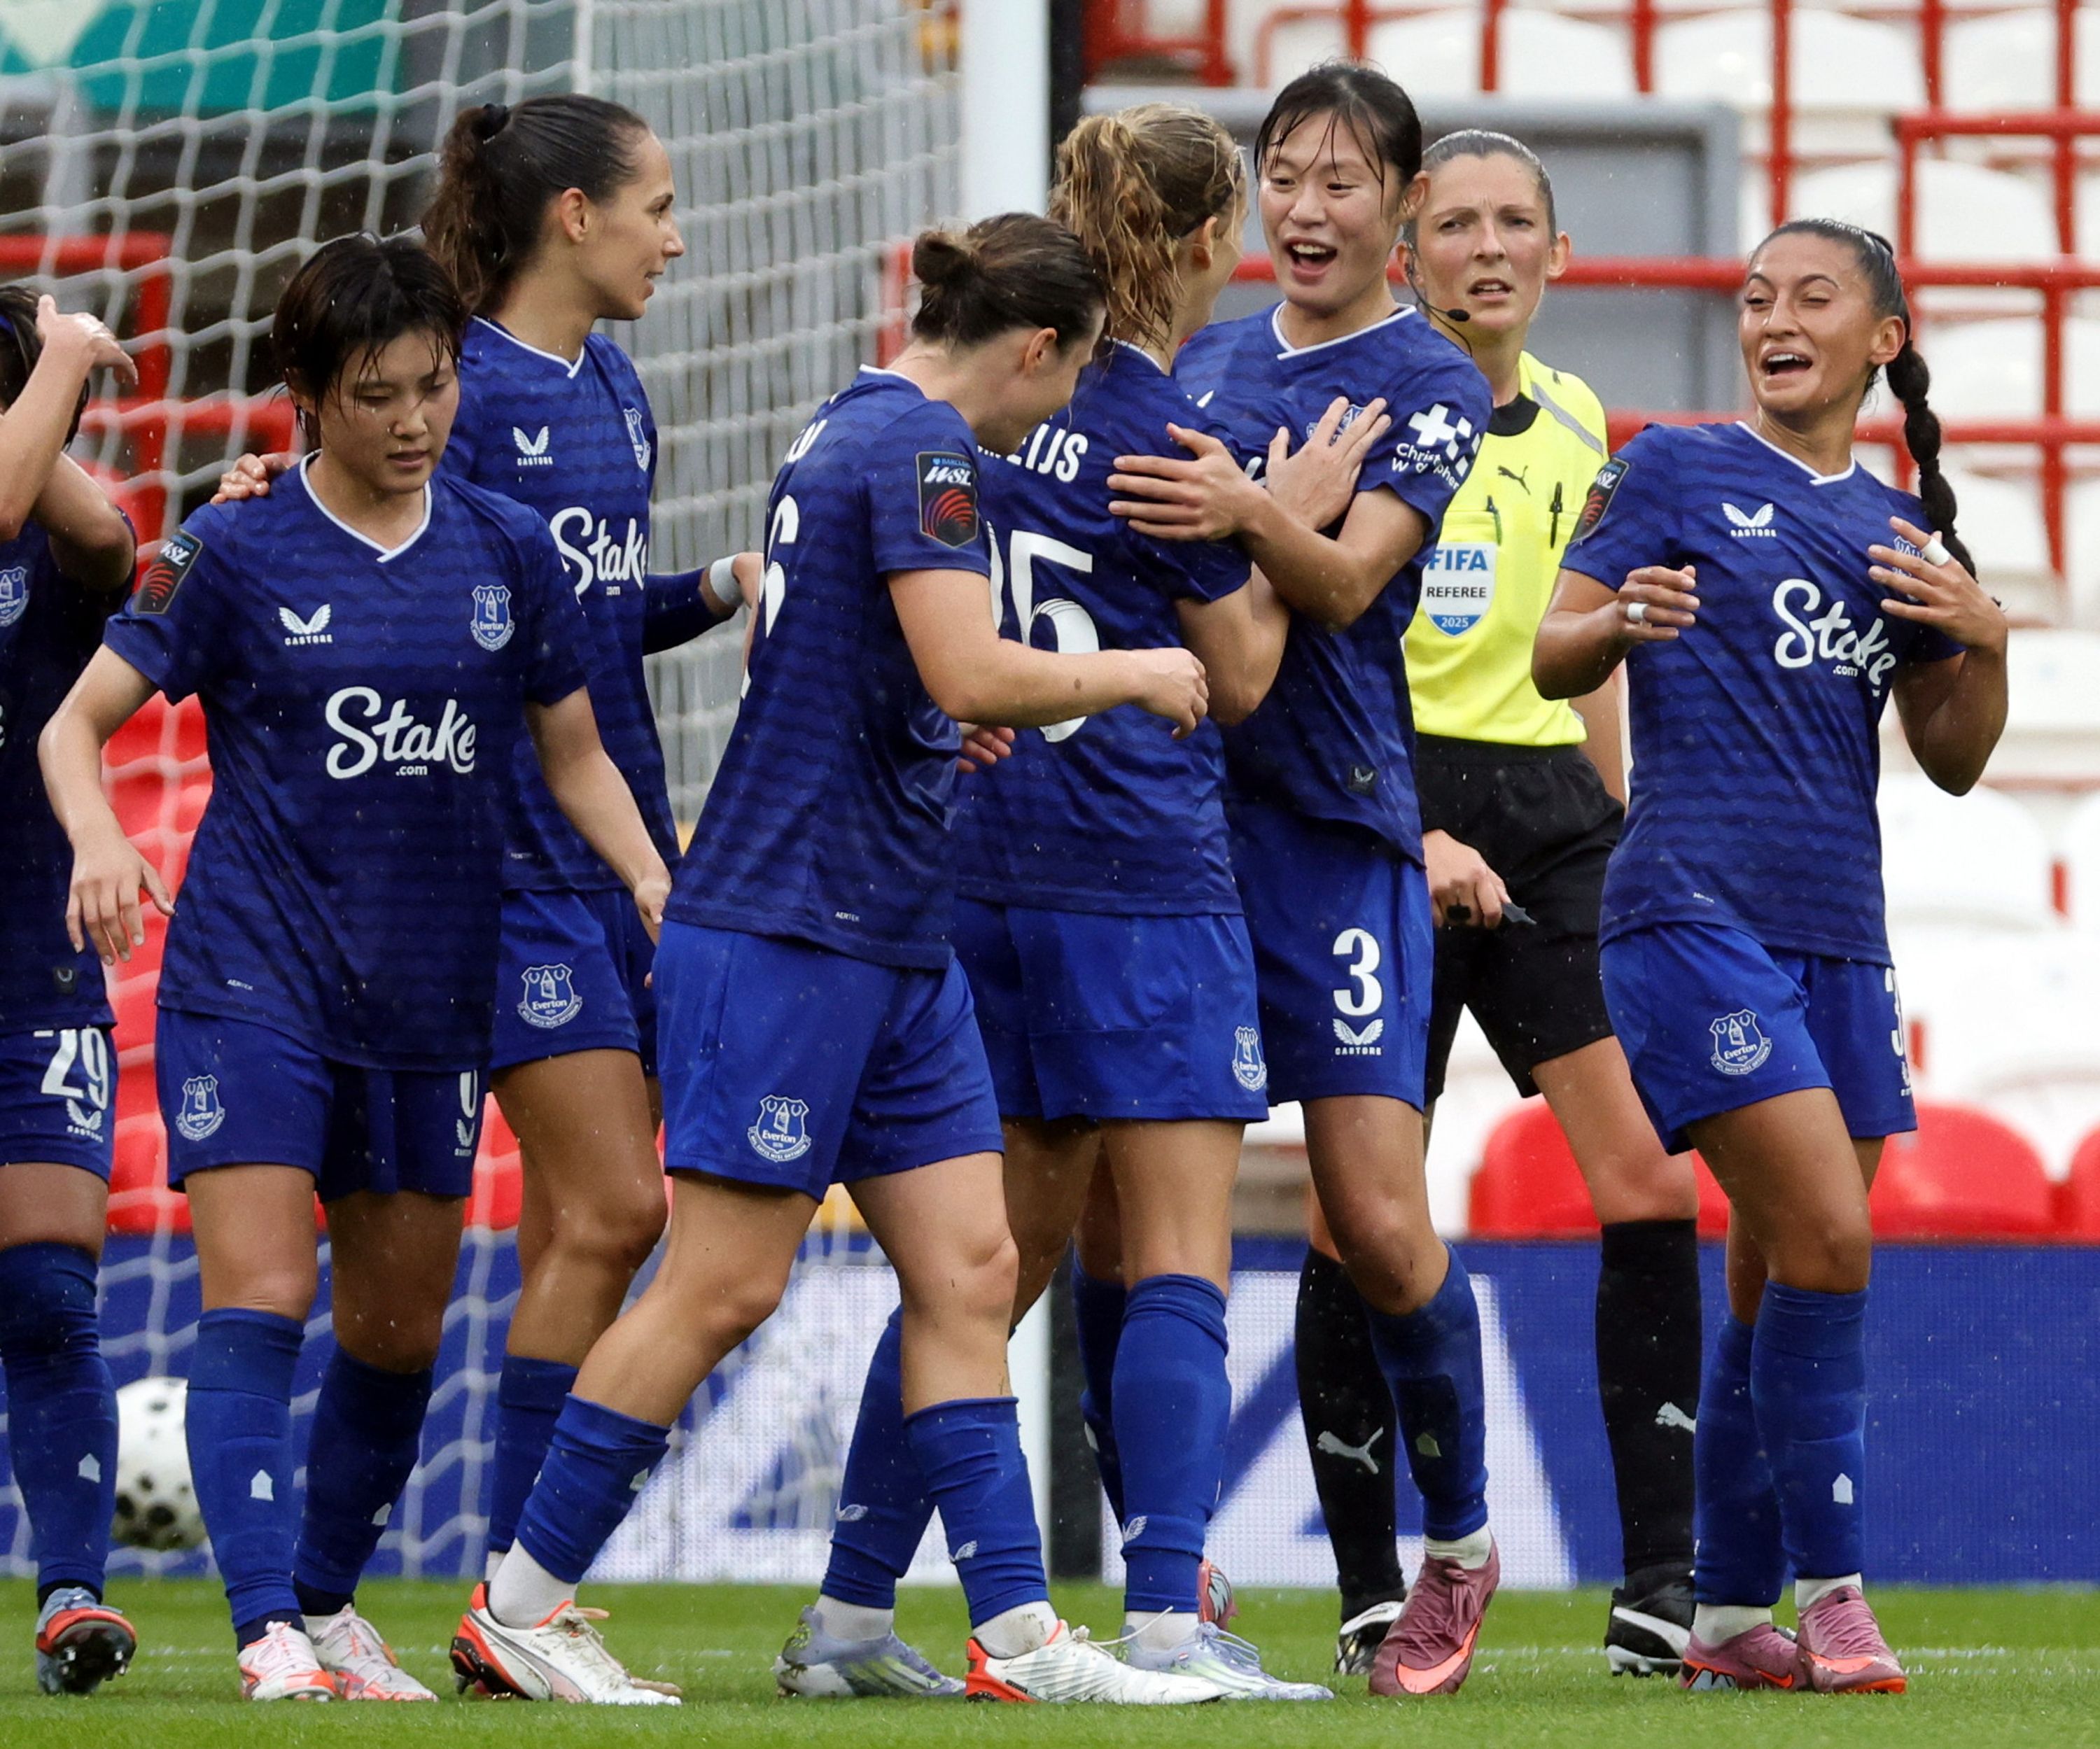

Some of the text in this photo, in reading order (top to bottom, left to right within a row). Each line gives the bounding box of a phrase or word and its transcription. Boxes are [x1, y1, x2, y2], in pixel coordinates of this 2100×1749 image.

[924, 466, 972, 486] WSL
[1429, 549, 1488, 571] FIFA
[1427, 586, 1487, 598] REFEREE
[1441, 617, 1469, 628] 2025
[1773, 578, 1896, 686] Stake
[1833, 664, 1858, 677] .com
[326, 686, 476, 780] Stake
[396, 765, 428, 776] .com
[1333, 927, 1383, 1016] 3
[533, 999, 568, 1011] Everton
[1724, 1044, 1758, 1060] Everton
[762, 1129, 797, 1144] Everton
